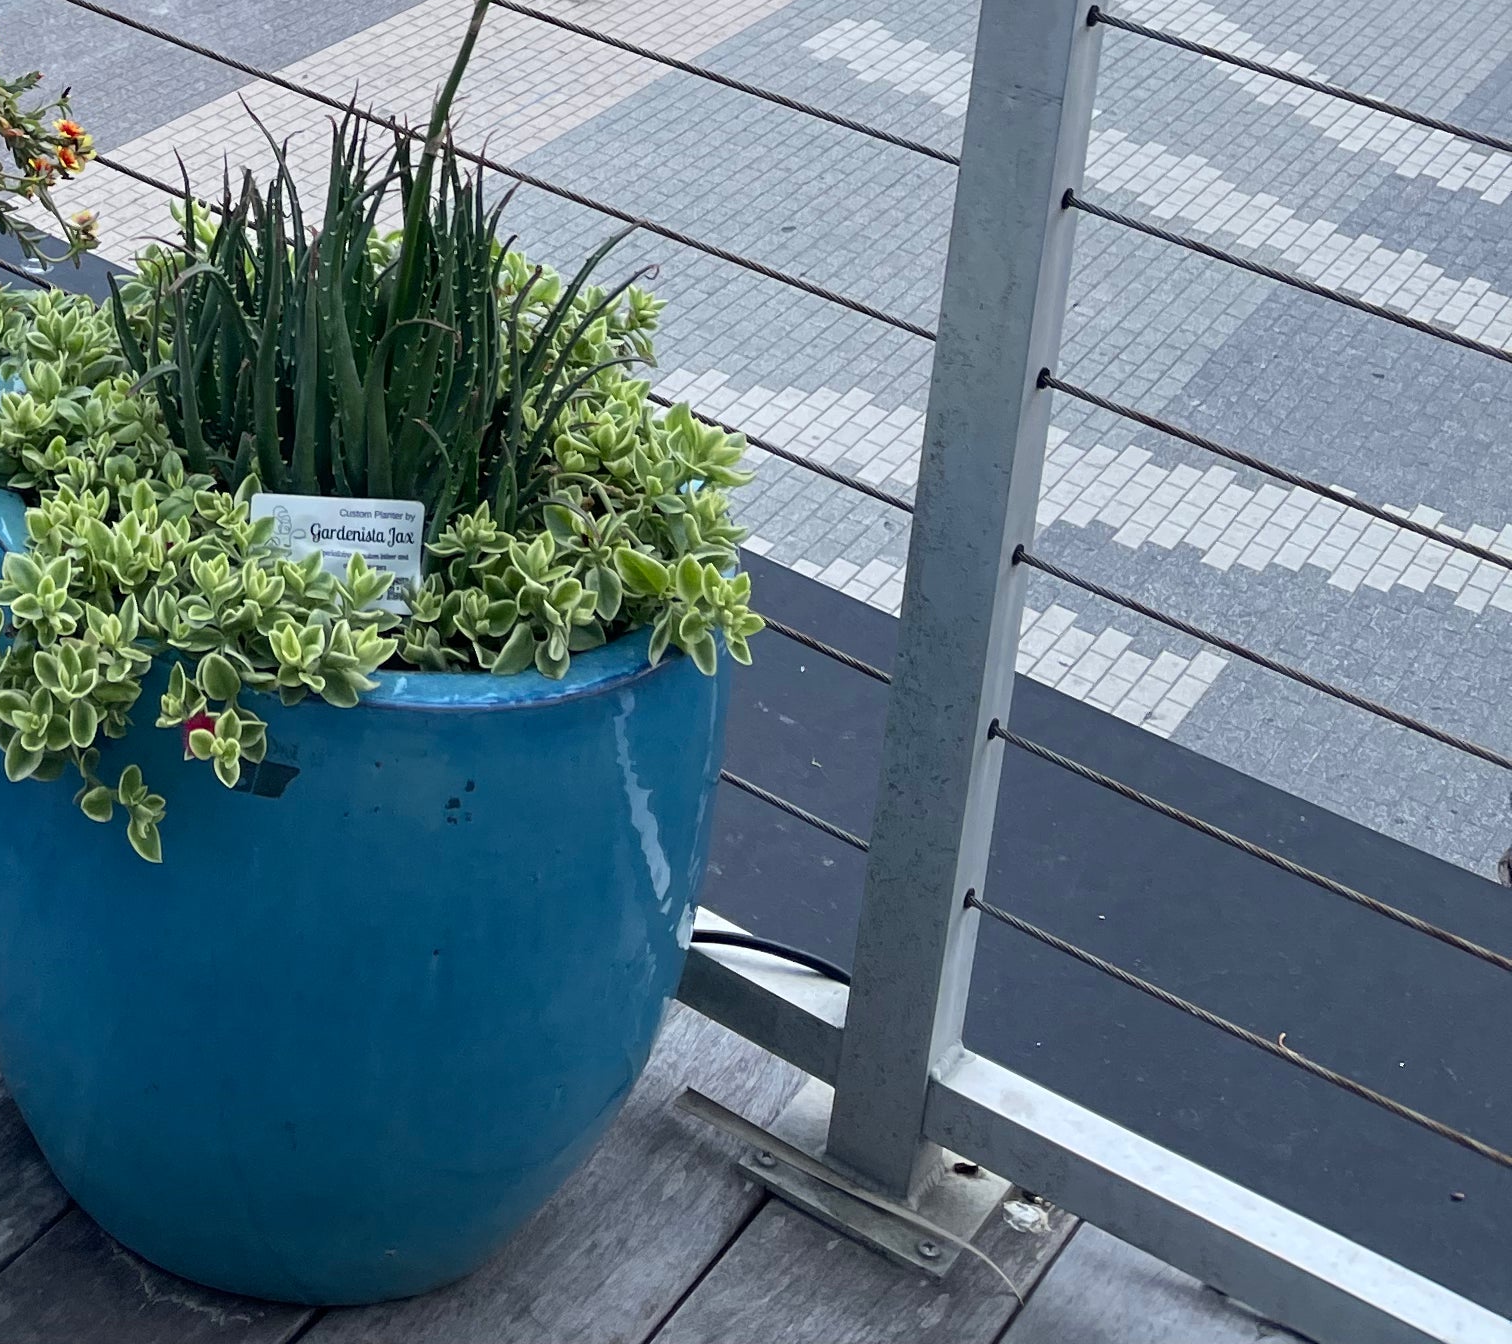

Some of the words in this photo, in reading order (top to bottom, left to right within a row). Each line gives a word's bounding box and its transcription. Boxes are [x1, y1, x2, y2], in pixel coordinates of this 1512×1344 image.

[339, 509, 372, 518] Custom
[374, 511, 403, 520] Planter
[405, 513, 416, 522] by
[310, 522, 385, 543] Gardenista
[386, 527, 415, 547] Jax
